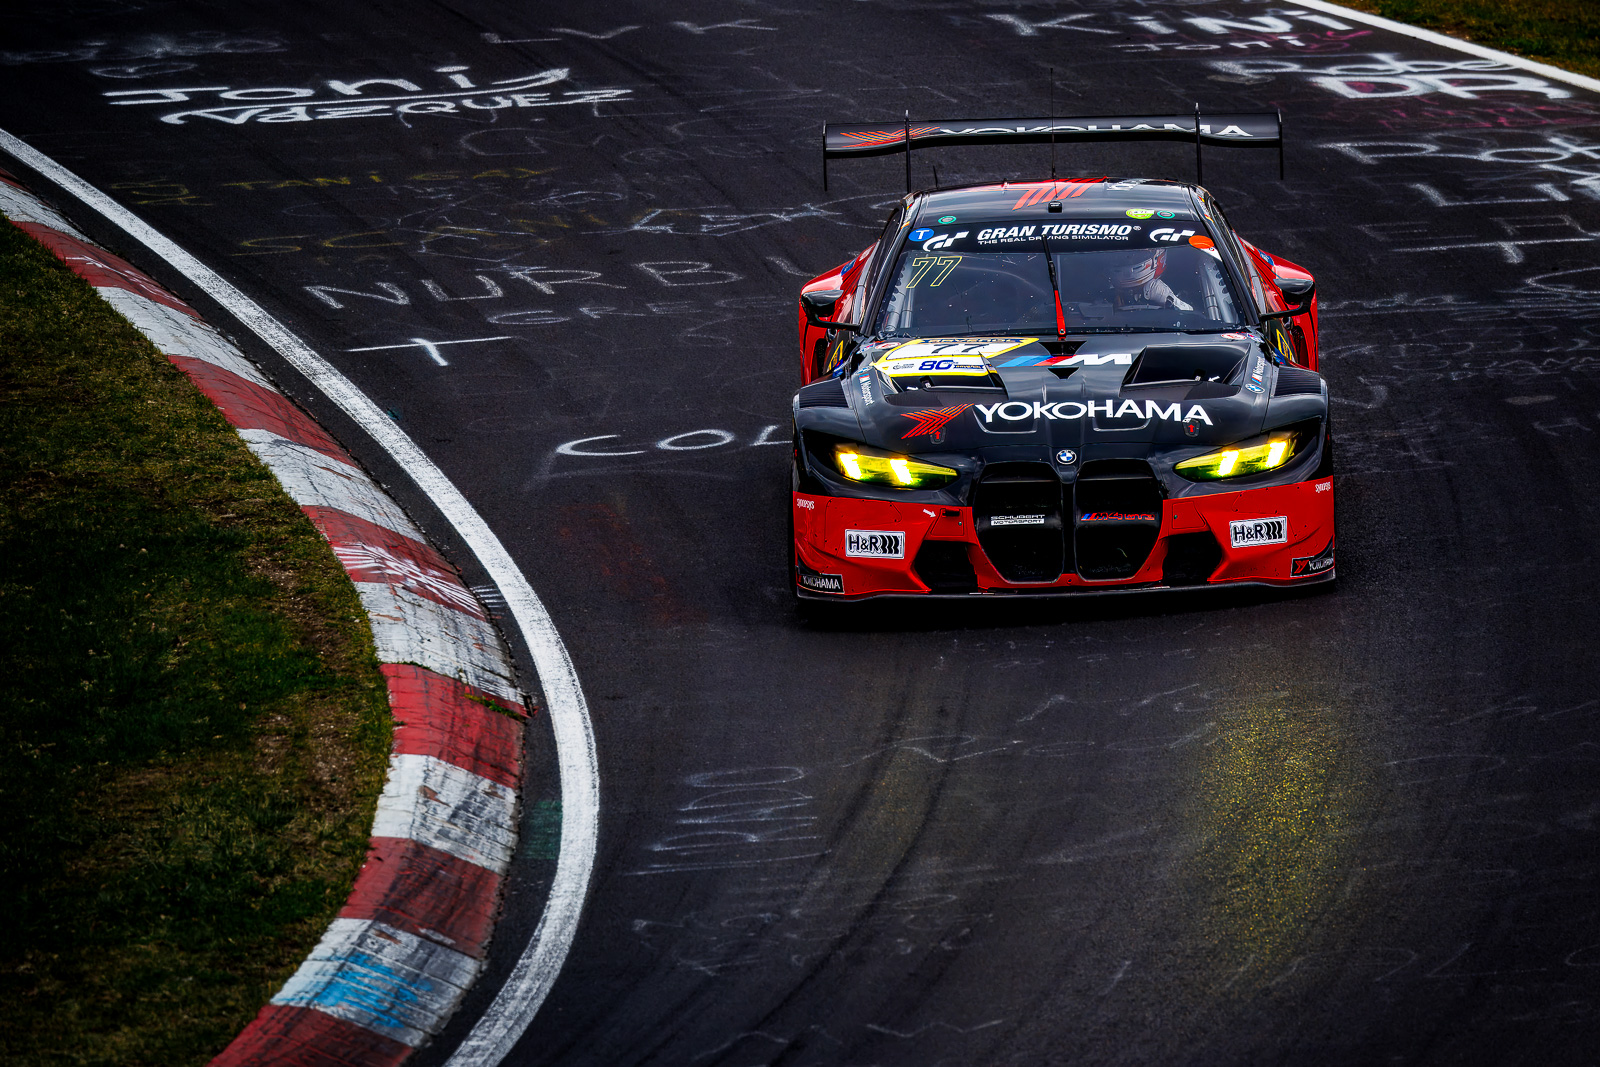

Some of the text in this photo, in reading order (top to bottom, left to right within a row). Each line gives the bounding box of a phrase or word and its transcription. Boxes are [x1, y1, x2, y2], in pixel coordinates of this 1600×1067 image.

[977, 225, 1036, 240] GRAN
[906, 256, 963, 289] 77
[930, 343, 990, 354] 77
[974, 398, 1213, 426] YOKOHAMA
[1232, 523, 1267, 543] H&R
[848, 533, 883, 554] H&R
